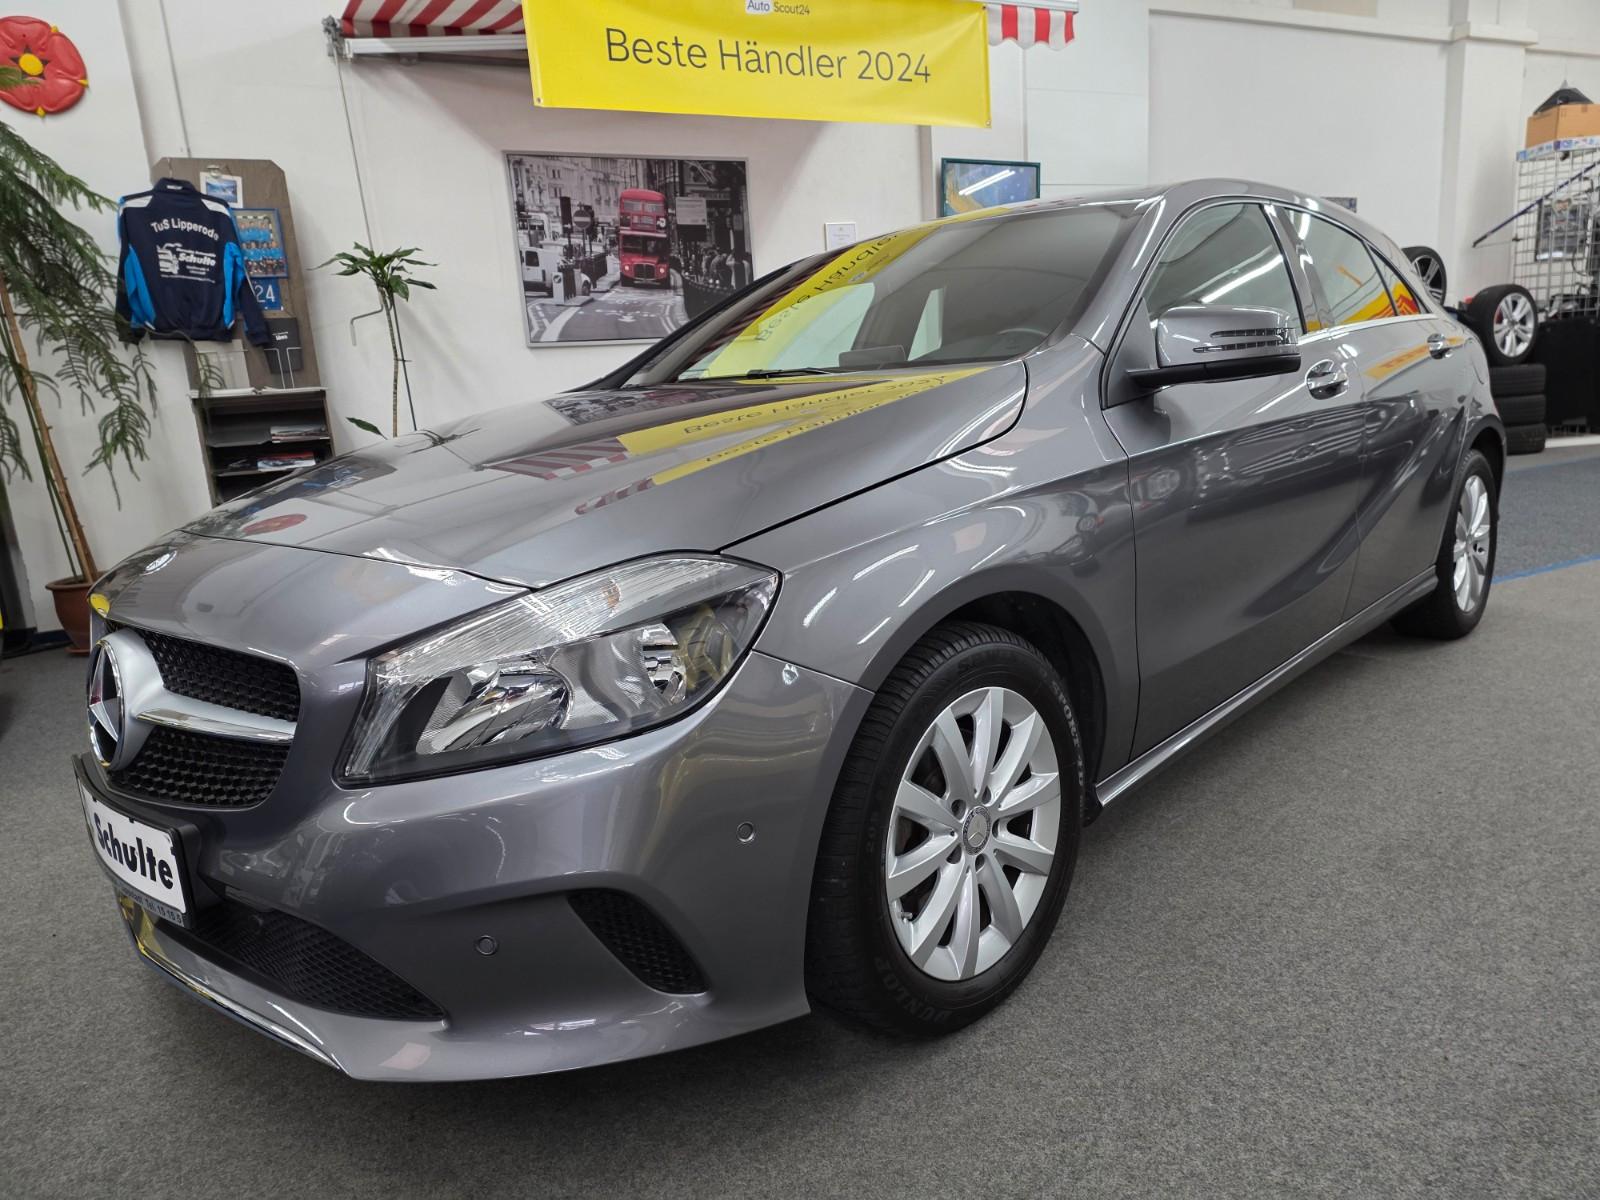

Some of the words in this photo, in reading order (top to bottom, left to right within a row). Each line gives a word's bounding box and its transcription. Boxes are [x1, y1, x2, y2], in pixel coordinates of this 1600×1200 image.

[747, 0, 771, 12] Auto
[773, 1, 811, 16] Scout24
[605, 27, 708, 69] Beste
[718, 39, 847, 79] Händler
[857, 50, 931, 84] 2024
[150, 218, 171, 233] TuS
[171, 217, 220, 241] Lipperode
[178, 252, 217, 267] Schulte
[93, 812, 174, 890] Schulte
